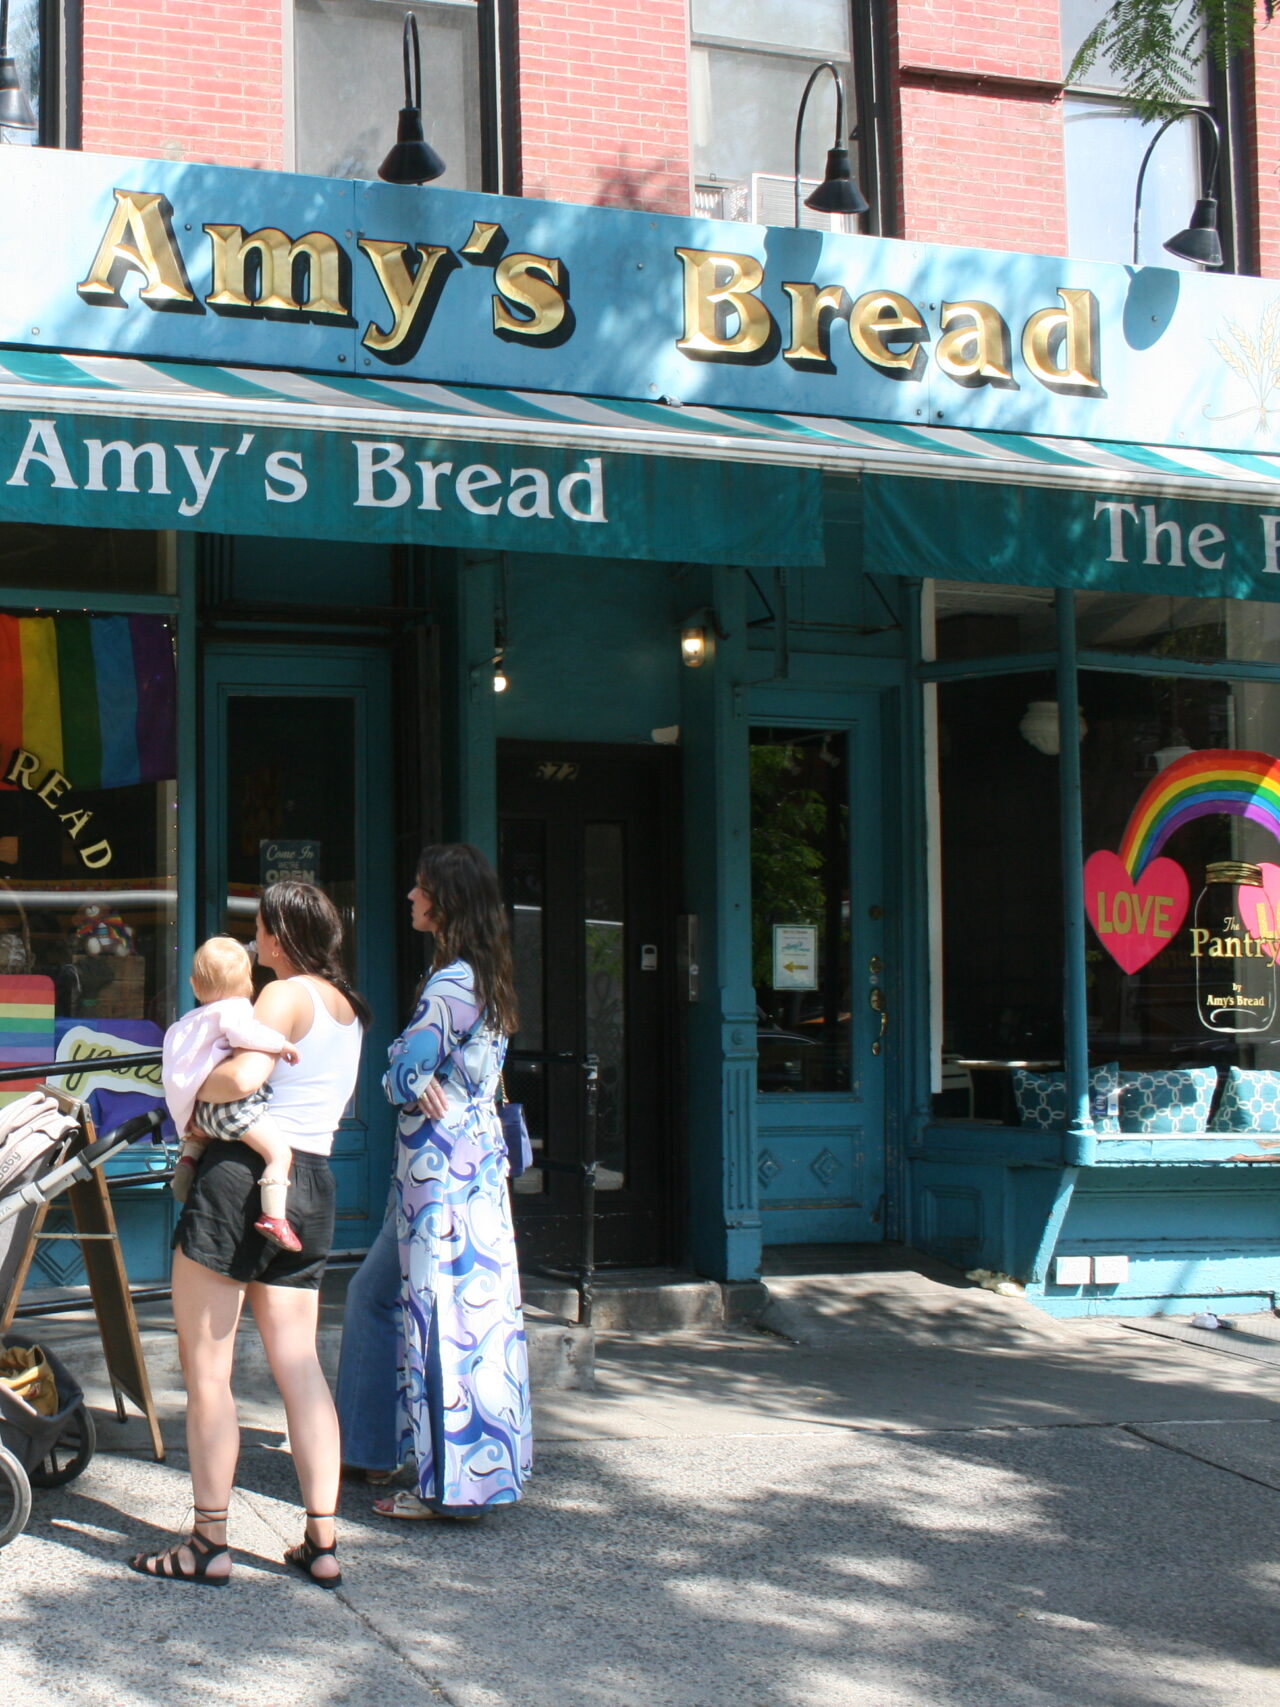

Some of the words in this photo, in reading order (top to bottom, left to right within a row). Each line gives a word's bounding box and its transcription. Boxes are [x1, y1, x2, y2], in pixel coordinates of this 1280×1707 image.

[78, 188, 573, 363] Amy's
[675, 247, 1106, 397] Bread
[7, 419, 308, 517] Amy's
[353, 440, 609, 524] Bread
[1093, 500, 1226, 570] The
[266, 845, 296, 861] Come
[298, 845, 315, 860] In
[1097, 891, 1174, 939] LOVE
[1223, 916, 1240, 932] The
[1189, 927, 1280, 968] Pantry
[1206, 994, 1235, 1009] Amy's
[1236, 994, 1265, 1007] Bread
[1232, 982, 1242, 993] by
